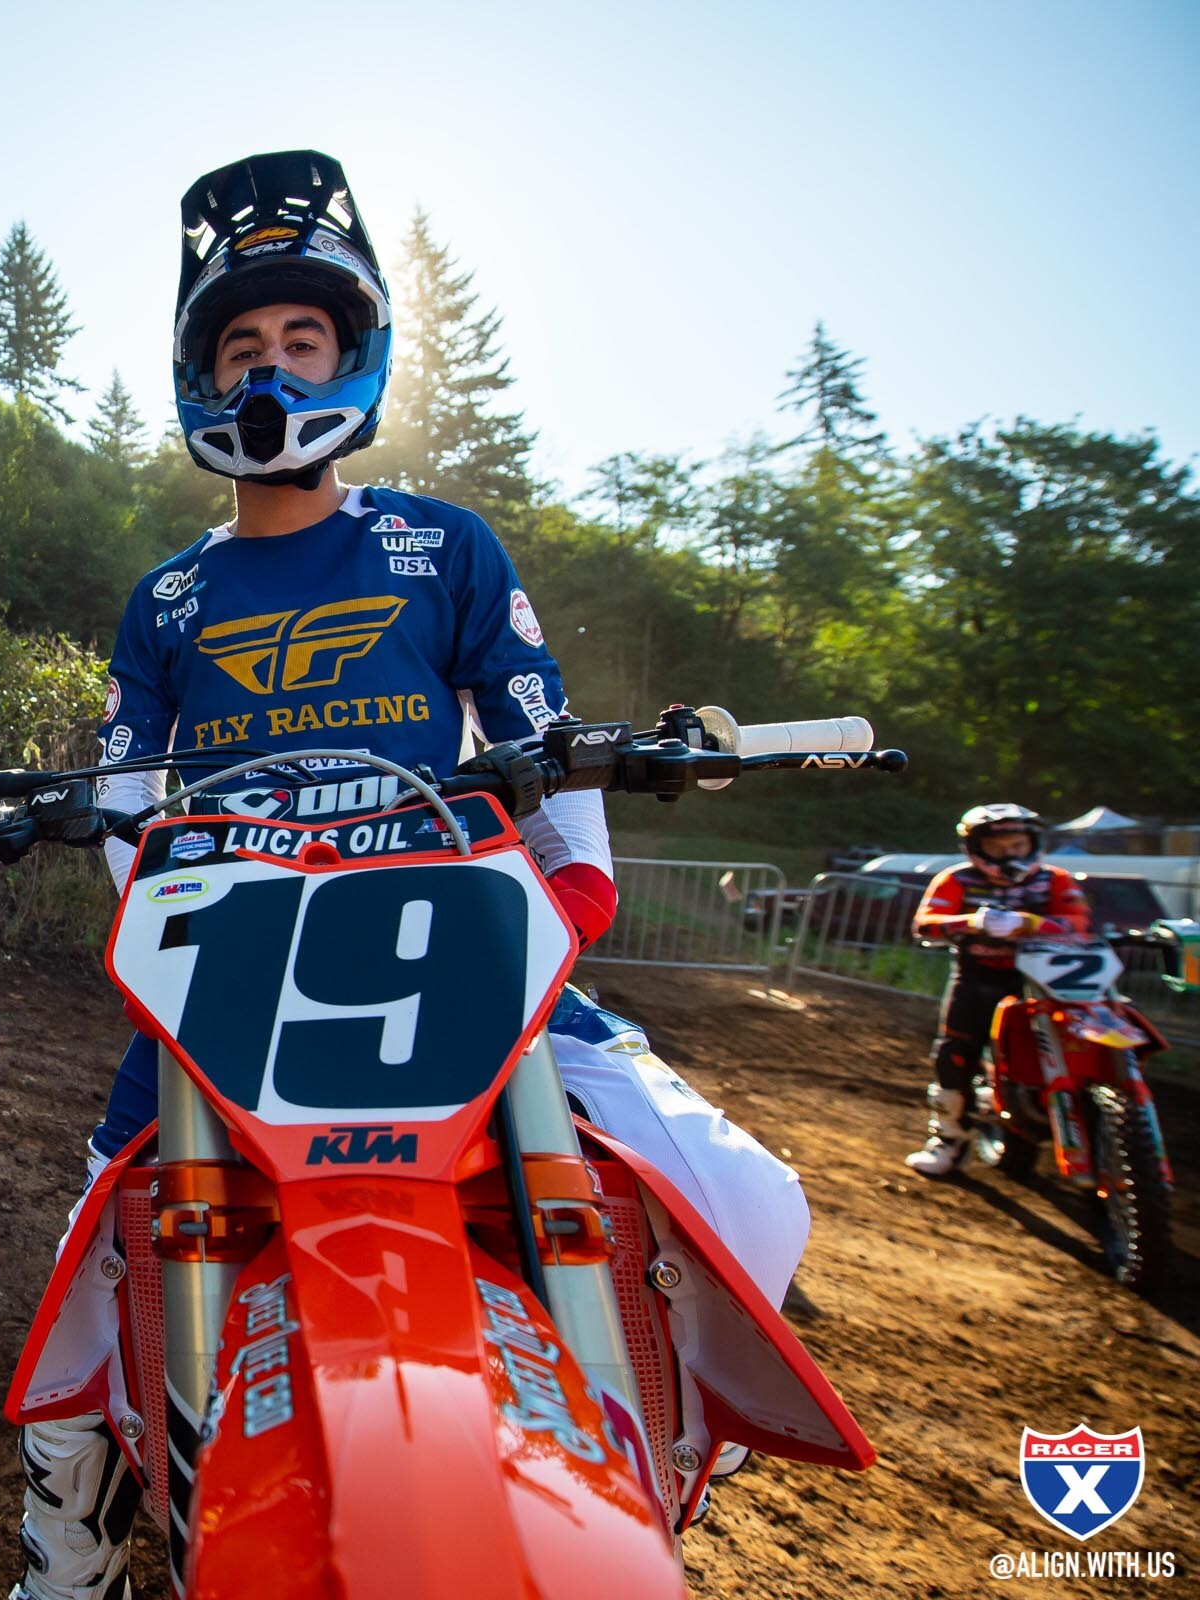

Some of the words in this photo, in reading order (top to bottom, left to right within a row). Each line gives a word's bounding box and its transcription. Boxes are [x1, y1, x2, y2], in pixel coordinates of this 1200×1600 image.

[415, 530, 442, 540] PRO
[193, 713, 254, 750] FLY
[266, 693, 430, 738] RACING
[109, 726, 132, 758] CBD
[570, 728, 622, 748] ASV
[800, 752, 869, 770] ASV
[31, 788, 69, 806] ASV
[177, 835, 196, 844] LUCAS
[223, 826, 338, 856] LUCAS
[349, 822, 407, 853] OIL
[153, 882, 185, 898] AMA
[1046, 953, 1104, 990] 2
[158, 864, 529, 1112] 19
[305, 1125, 418, 1165] KTM
